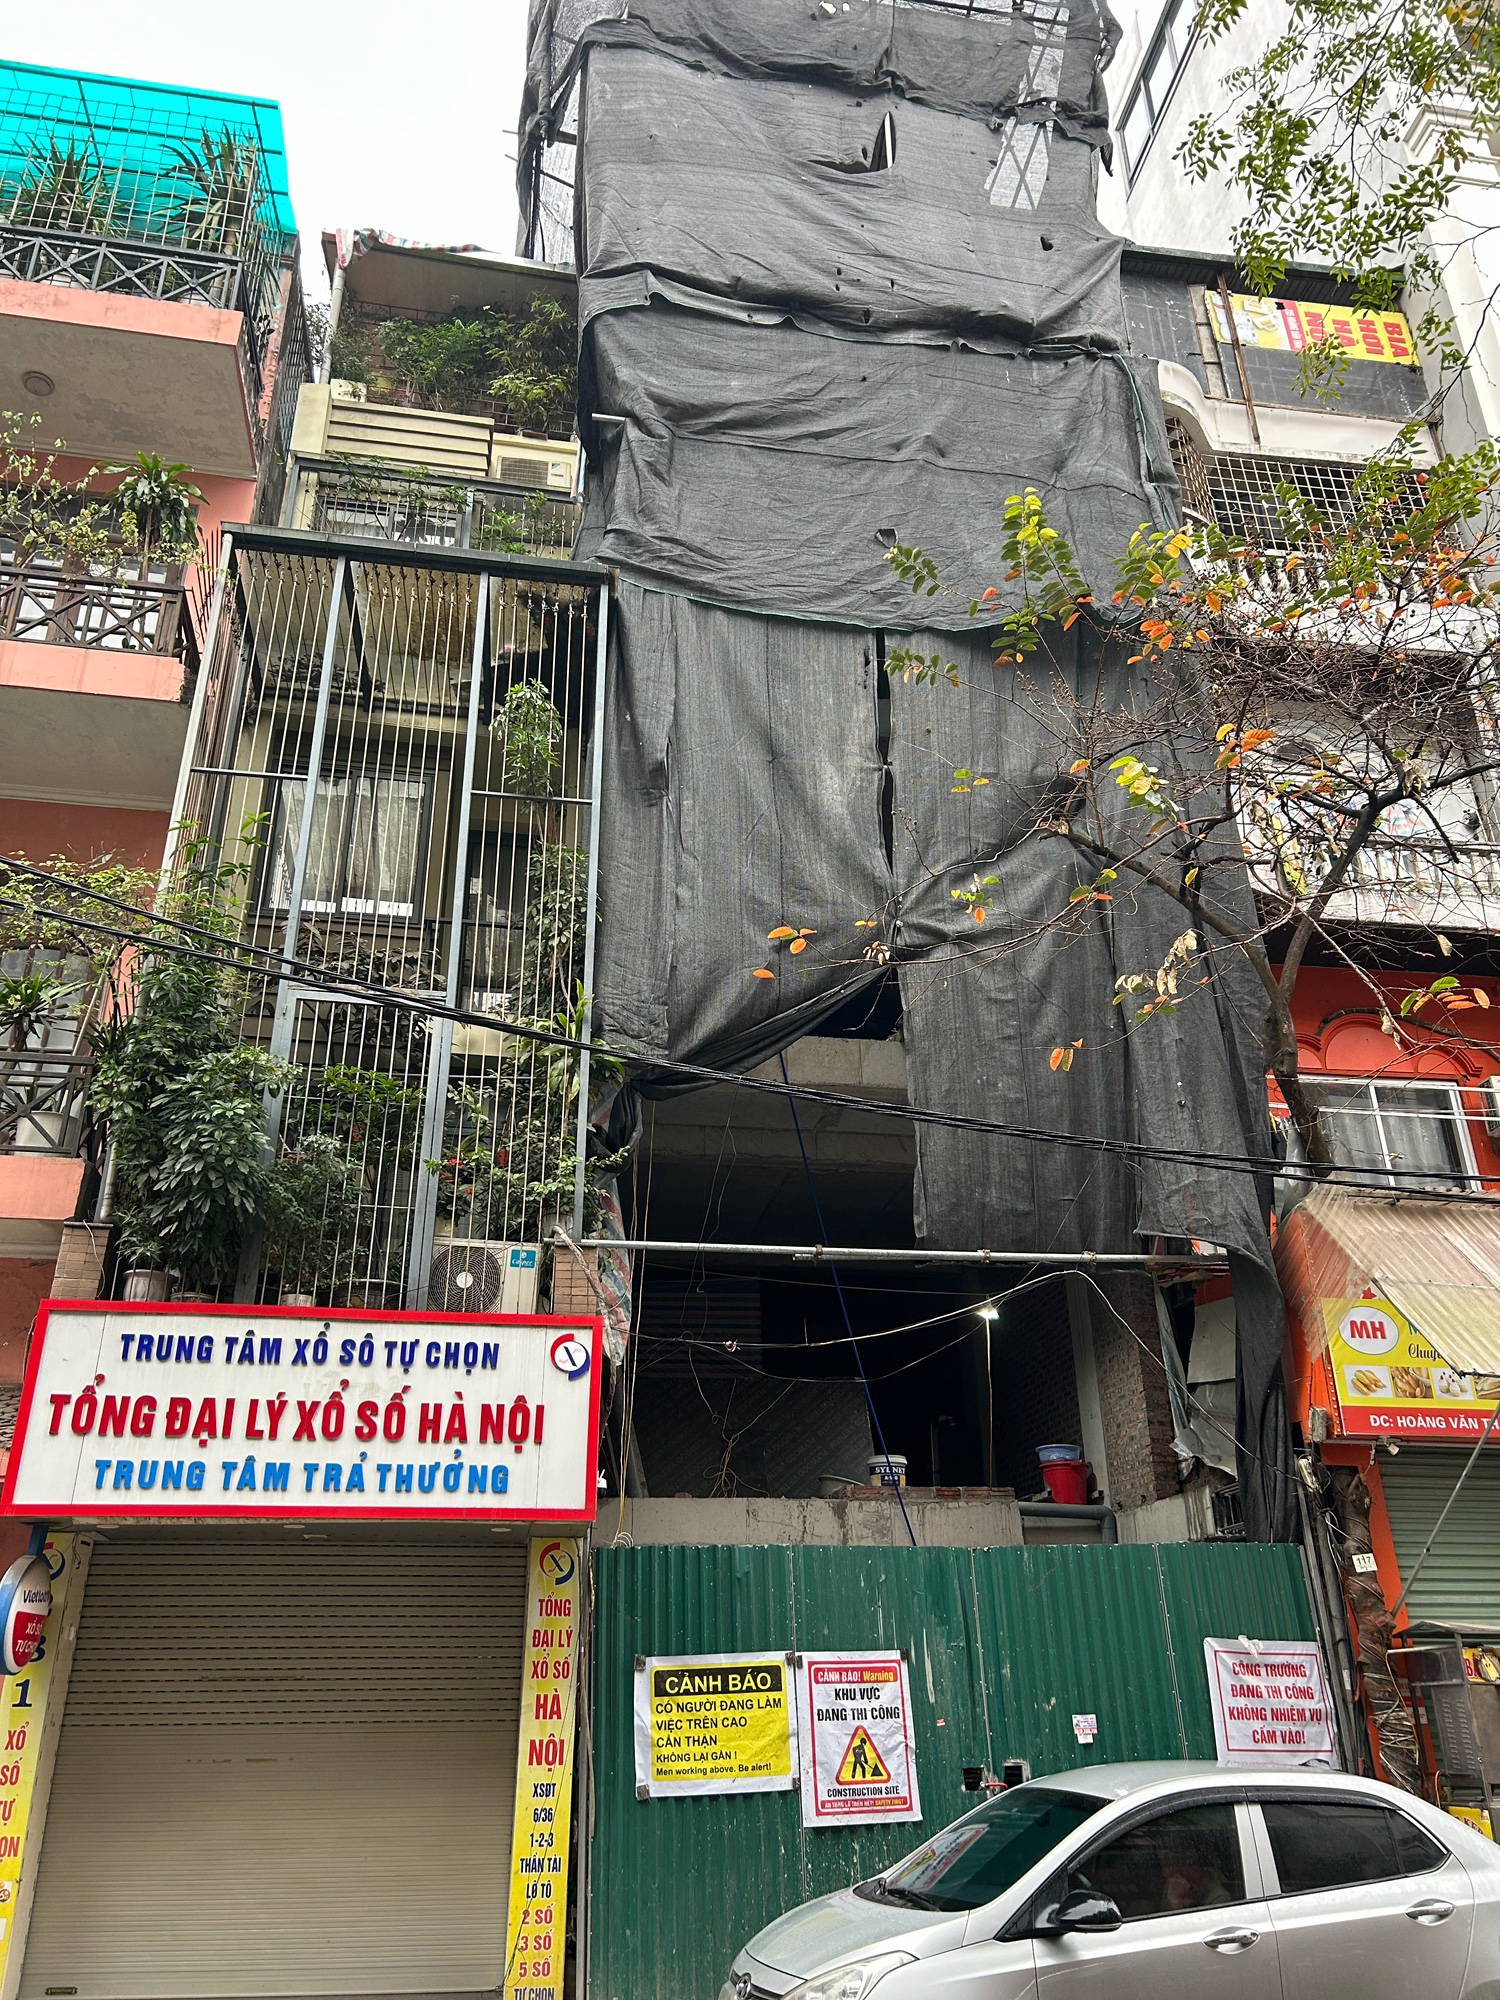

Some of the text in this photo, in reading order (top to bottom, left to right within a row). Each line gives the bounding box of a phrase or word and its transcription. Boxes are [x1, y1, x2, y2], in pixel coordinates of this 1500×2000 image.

[1357, 318, 1384, 355] HƠI
[1384, 321, 1410, 357] BIA
[1349, 1319, 1387, 1340] MH
[121, 1334, 214, 1363] TRUNG
[225, 1330, 282, 1365] TÂM
[291, 1321, 330, 1366] XỔ
[384, 1339, 420, 1374] TỰ
[425, 1341, 500, 1375] CHỌN
[49, 1374, 545, 1453] TỔNG ĐẠI LÝ XỔ SỐ HÀ NỘI
[1369, 1415, 1394, 1428] ĐC:
[1397, 1413, 1446, 1429] HOÀNG
[1448, 1414, 1479, 1430] VĂN
[95, 1449, 509, 1493] TRUNG TÂM TRẢ THƯỞNG
[538, 1592, 572, 1617] TỔNG
[532, 1625, 573, 1652] ĐẠI LÝ
[531, 1653, 571, 1679] XỔ SỐ
[863, 1670, 894, 1681] Warning
[1232, 1660, 1307, 1678] CÔNG TRƯỜNG
[665, 1668, 772, 1694] CẢNH BÁO
[1231, 1683, 1314, 1700] ĐANG THI CÔNG
[535, 1688, 562, 1720] HÀ
[655, 1696, 782, 1714] CÓ NGƯỜI ĐANG LÀM
[834, 1686, 880, 1703] KHU VỰC
[817, 1704, 900, 1721] ĐANG THI CÔNG
[1228, 1703, 1322, 1725] KHÔNG NHIỆM VỤ
[656, 1715, 748, 1733] VIỆC TRÊN CAO
[5, 1721, 30, 1750] XỔ
[685, 1733, 717, 1748] THẬN
[1252, 1725, 1306, 1745] CẤM VÀO!
[528, 1733, 565, 1772] NỘI
[656, 1751, 691, 1763] KHÔNG
[693, 1752, 708, 1763] LẠI
[0, 1757, 23, 1786] SỐ
[656, 1762, 772, 1776] Men working above. Be alert!
[827, 1785, 900, 1798] CONSTRUCTION SITE
[533, 1807, 553, 1822] 6/36
[530, 1832, 554, 1848] 1-2-3
[547, 1854, 561, 1873] TÀI
[541, 1880, 552, 1898] TÔ
[522, 1903, 554, 1925] 2 SỐ
[520, 1929, 553, 1952] 3 SỐ
[519, 1955, 552, 1977] 5 SỐ
